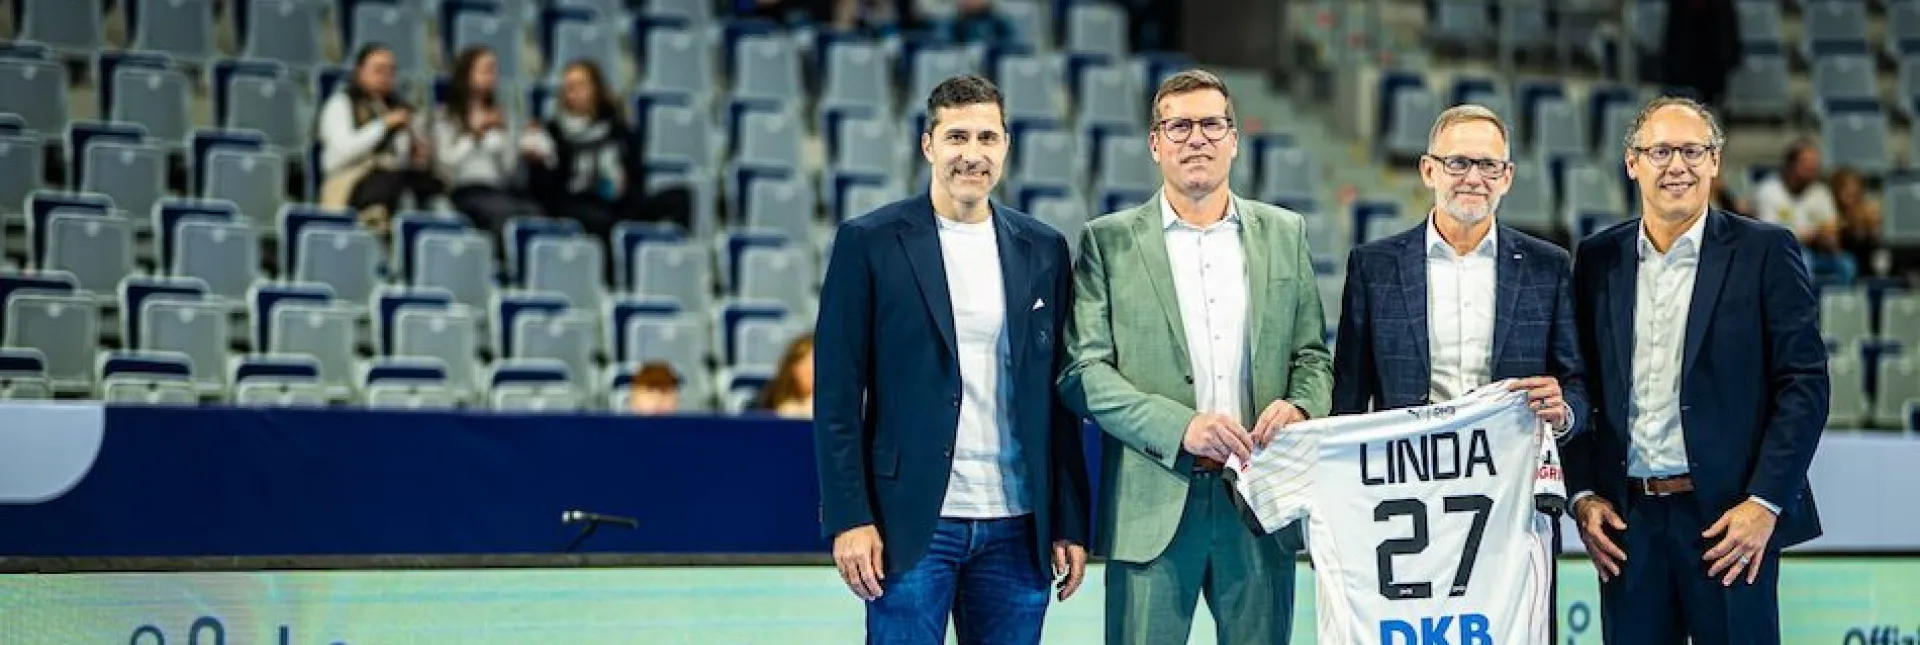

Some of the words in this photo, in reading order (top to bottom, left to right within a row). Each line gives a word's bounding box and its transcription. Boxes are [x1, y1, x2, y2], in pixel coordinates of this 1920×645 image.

[1359, 429, 1497, 486] LINDA
[1373, 494, 1494, 601] 27
[1379, 613, 1493, 645] DKB
